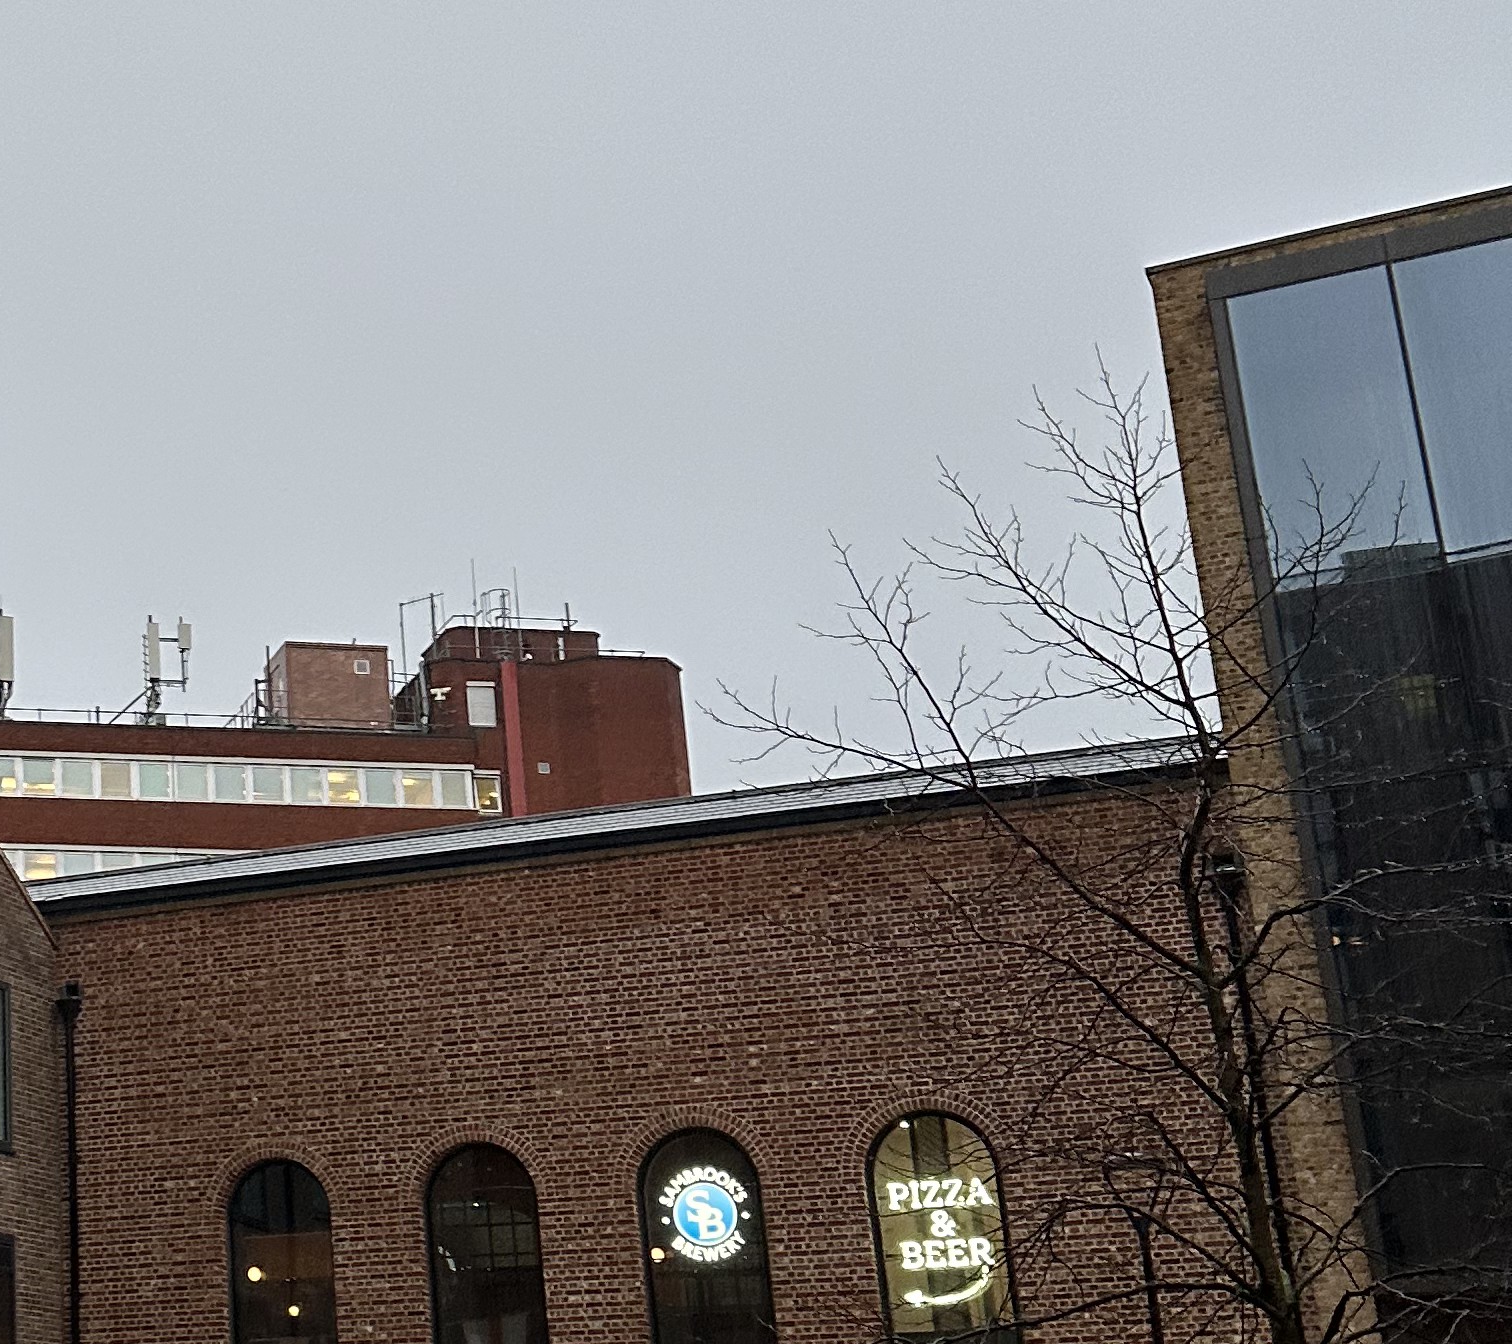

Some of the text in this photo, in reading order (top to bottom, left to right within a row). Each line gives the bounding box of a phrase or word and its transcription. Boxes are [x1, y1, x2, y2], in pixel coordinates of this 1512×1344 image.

[658, 1166, 748, 1208] SAMBROOK'S
[885, 1177, 997, 1211] PIZZA
[685, 1189, 727, 1240] SB
[930, 1210, 958, 1237] &
[671, 1230, 746, 1262] BREWERY
[898, 1237, 996, 1270] BEER
